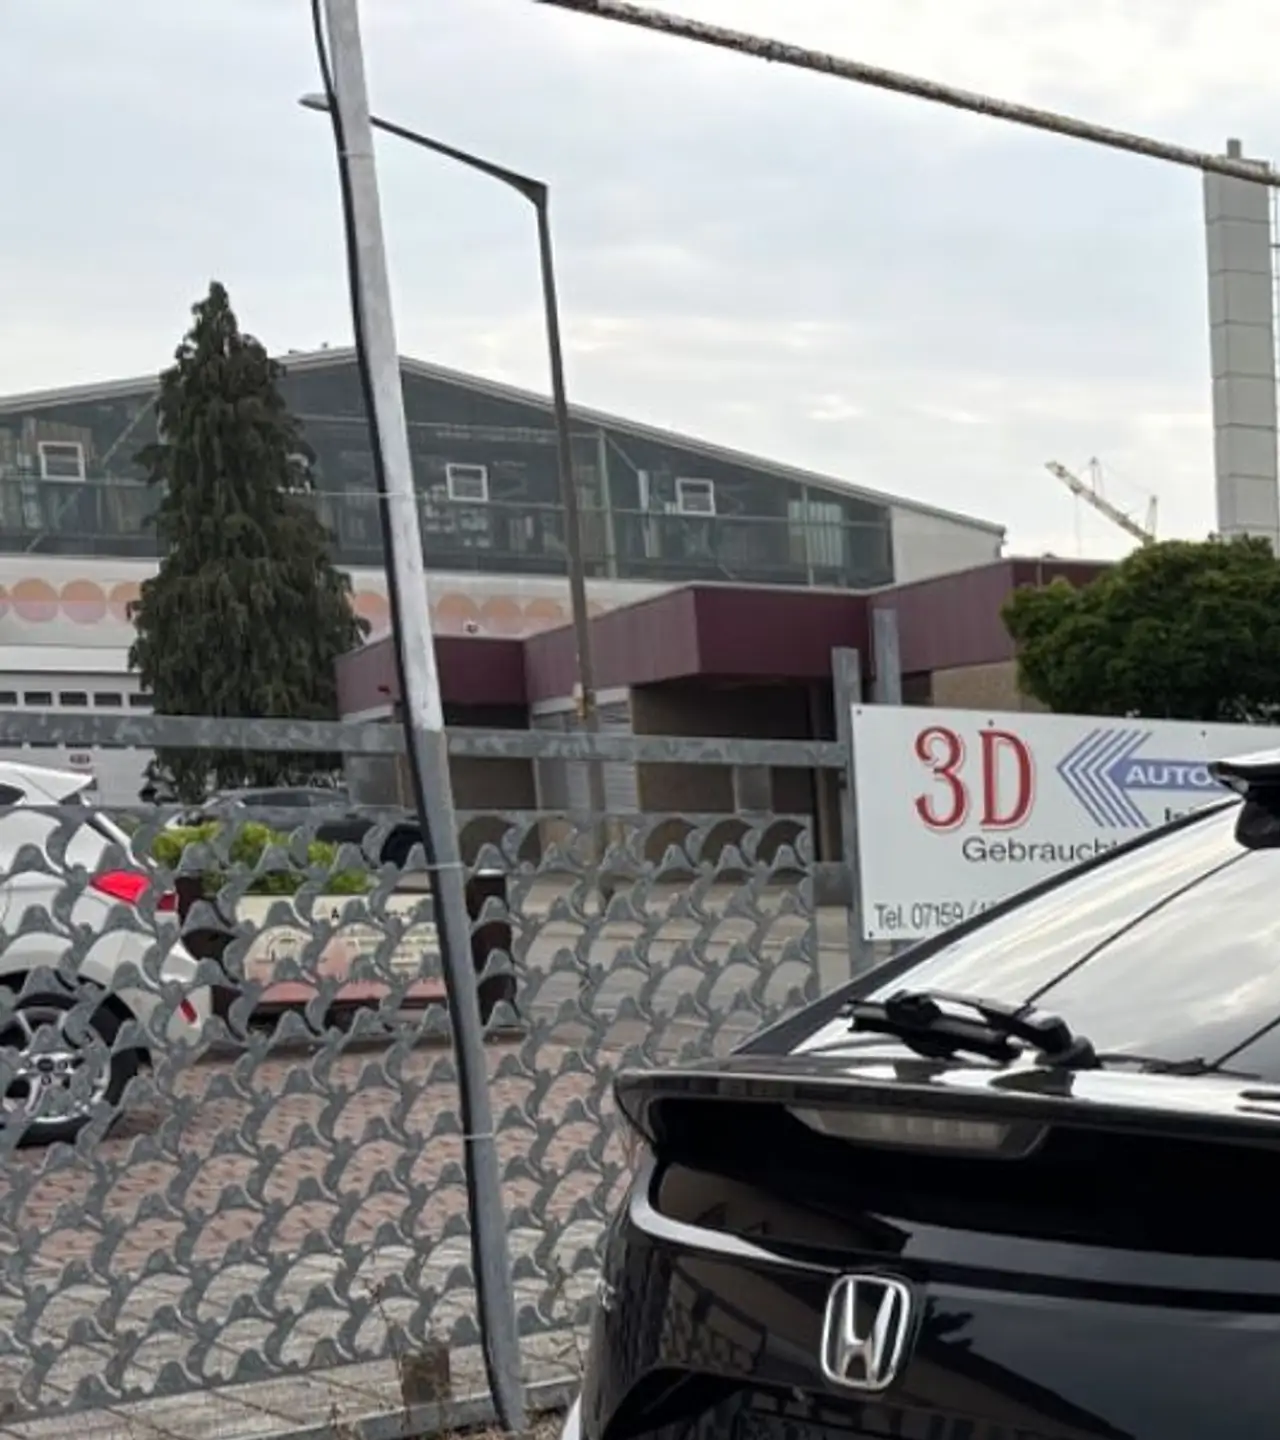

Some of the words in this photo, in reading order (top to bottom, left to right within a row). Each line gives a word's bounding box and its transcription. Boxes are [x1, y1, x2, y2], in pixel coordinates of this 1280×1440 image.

[914, 725, 1035, 831] 3D
[1125, 764, 1220, 788] AUTO
[961, 835, 1118, 864] Gebrauch
[873, 901, 908, 931] Tel.
